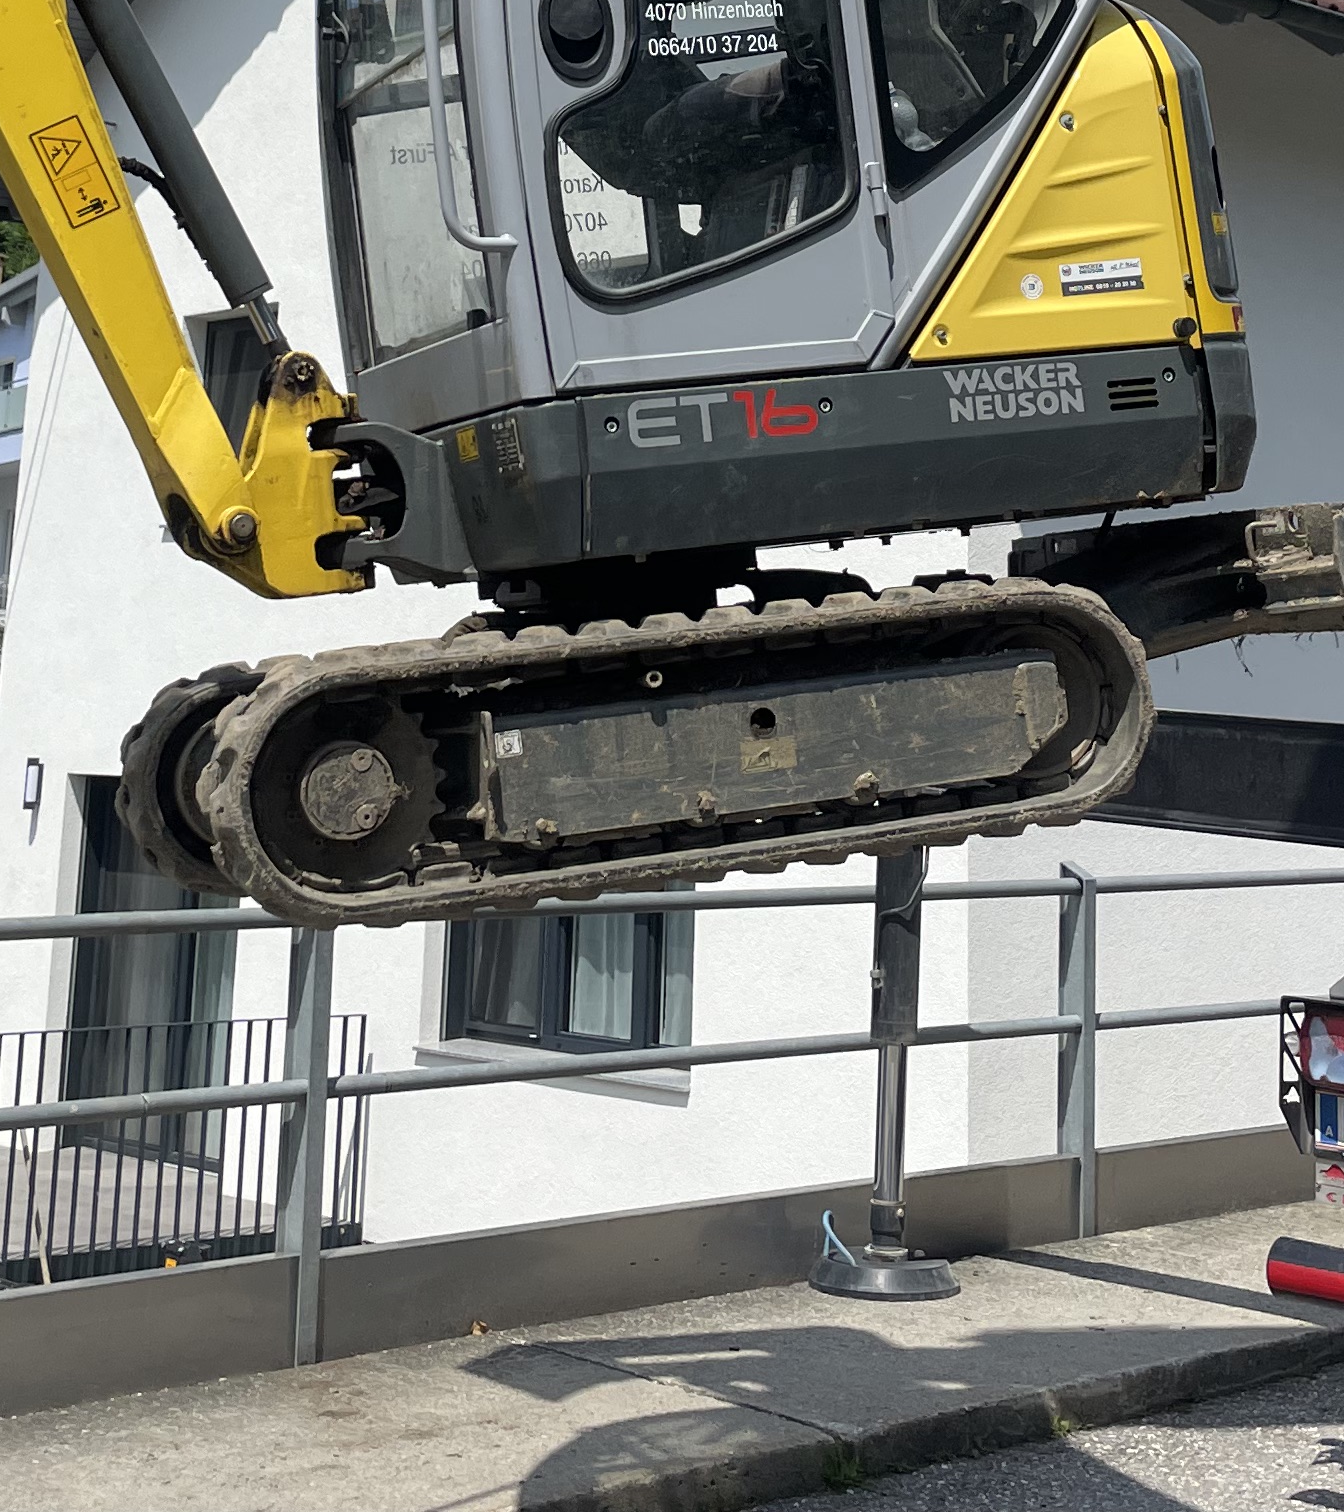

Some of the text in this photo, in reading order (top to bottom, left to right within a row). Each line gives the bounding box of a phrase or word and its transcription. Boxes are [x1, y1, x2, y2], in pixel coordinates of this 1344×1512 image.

[644, 0, 784, 22] 4070 Hinzenbach
[648, 34, 779, 56] 0664/10 37 204
[943, 362, 1081, 394] WACKER
[626, 389, 819, 449] ET16
[949, 387, 1086, 423] NEUSON
